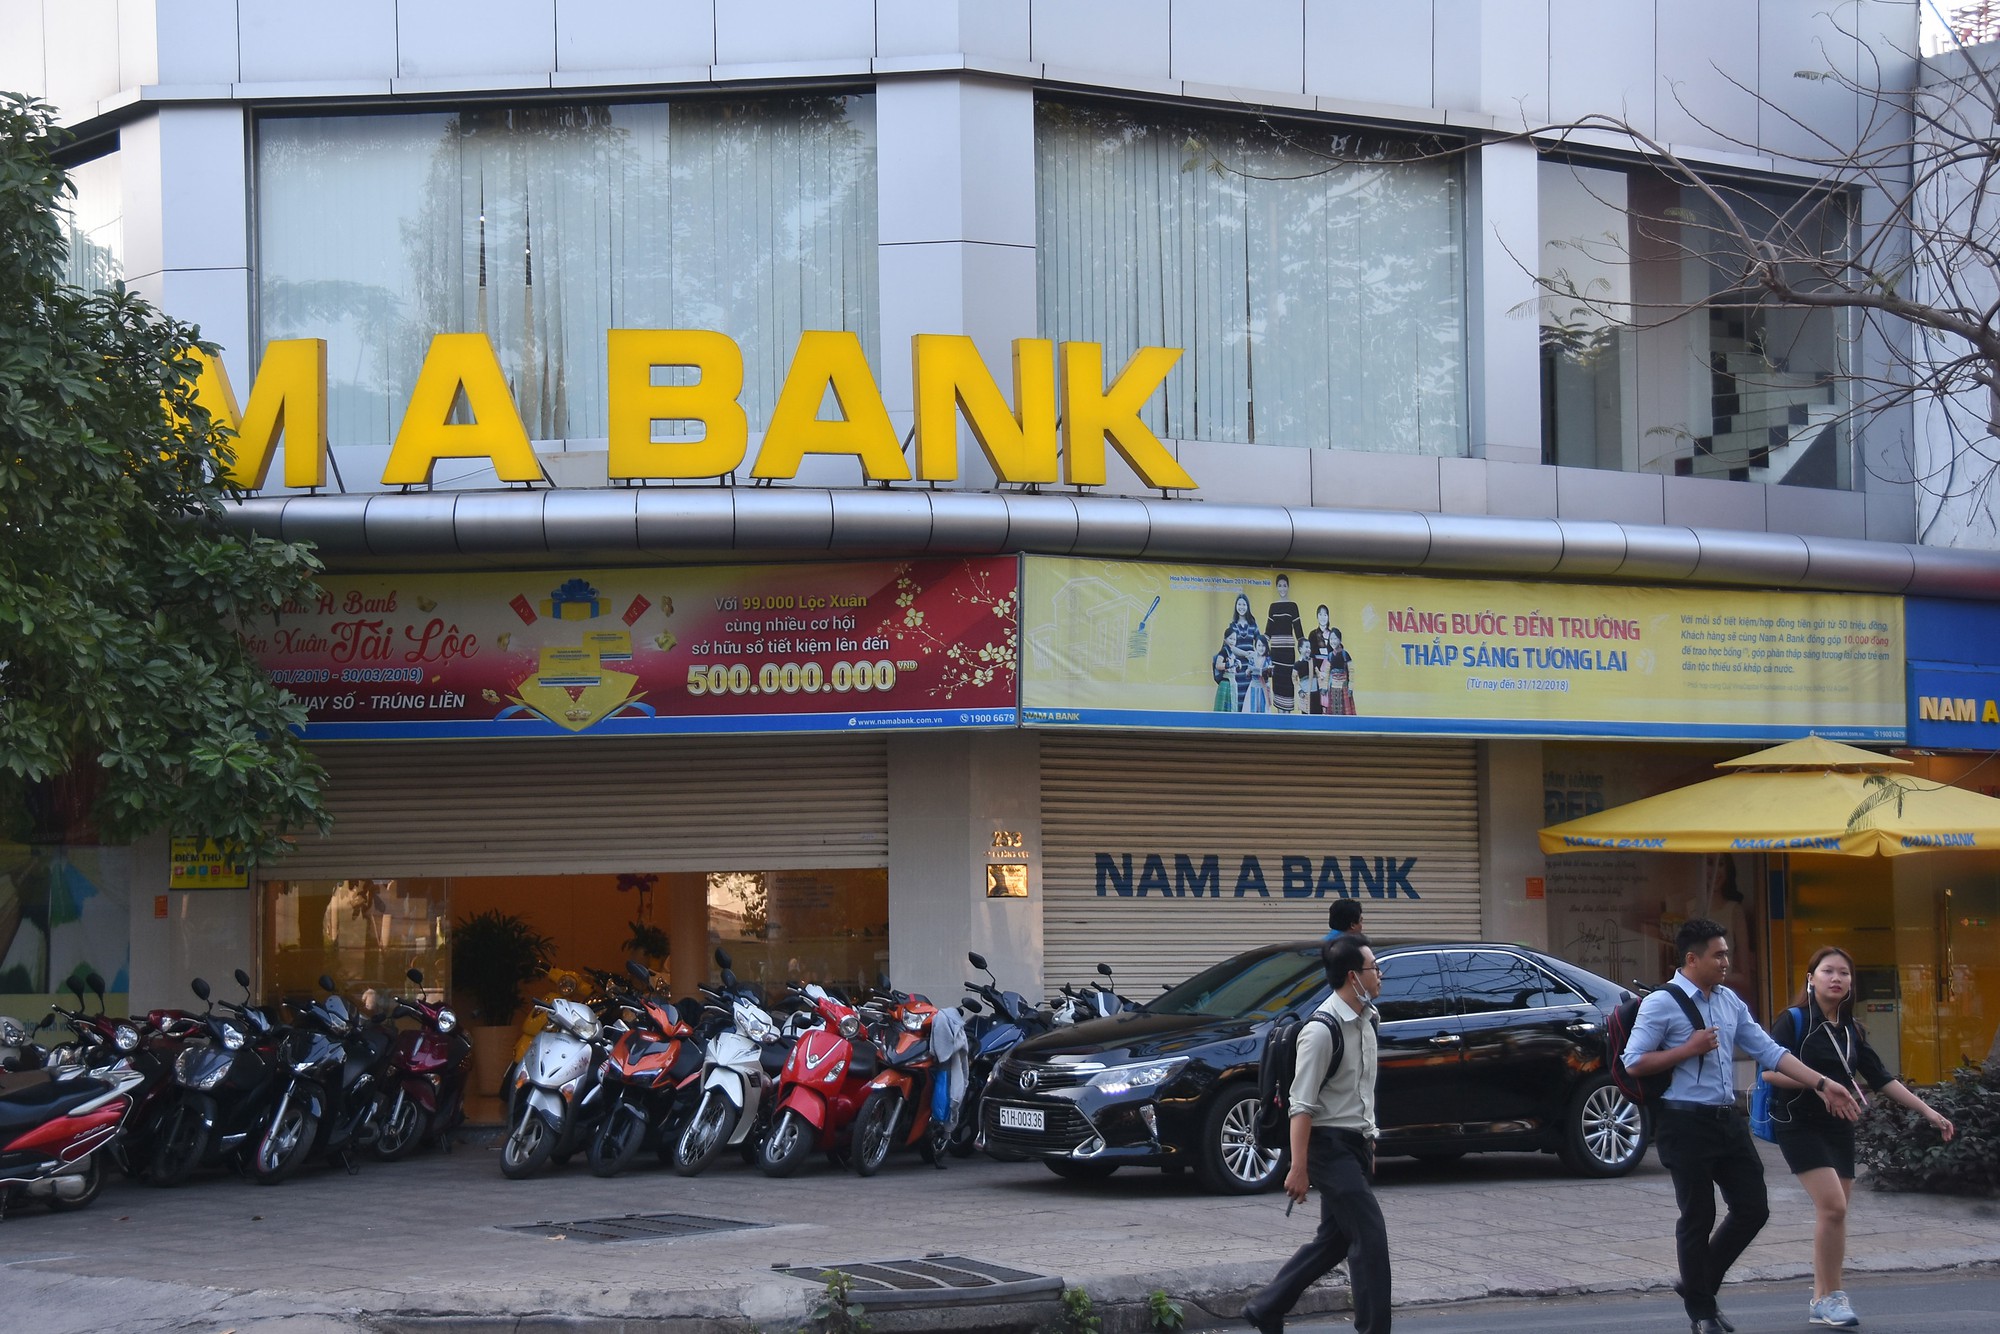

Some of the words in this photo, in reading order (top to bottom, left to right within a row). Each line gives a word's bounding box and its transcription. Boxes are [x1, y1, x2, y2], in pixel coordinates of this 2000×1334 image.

[381, 332, 545, 485] A
[607, 329, 1199, 489] BANK
[343, 590, 398, 614] Bank
[714, 597, 737, 610] Với
[742, 596, 794, 609] 99.000
[799, 596, 825, 611] Lộc
[830, 594, 867, 607] Xuân
[725, 619, 761, 634] cùng
[766, 616, 805, 631] nhiều
[811, 618, 829, 629] cơ
[833, 615, 855, 631] hội
[1387, 606, 1447, 635] NÂNG
[1451, 610, 1507, 636] BƯỚC
[1513, 609, 1554, 638] ĐẾN
[1558, 614, 1640, 640] TRƯỜNG
[1839, 620, 1847, 629] 50
[274, 628, 329, 654] Xuân
[330, 619, 394, 663] Tài
[405, 618, 480, 666] Lộc
[692, 640, 711, 654] sở
[714, 640, 741, 654] hữu
[767, 638, 791, 653] tiết
[796, 639, 831, 655] kiệm
[836, 638, 857, 651] lên
[862, 636, 889, 650] đến
[1759, 633, 1776, 642] Nam
[1778, 634, 1784, 642] A
[1787, 634, 1804, 643] Bank
[1844, 635, 1869, 644] 10.000
[1401, 637, 1458, 667] THẮP
[1462, 641, 1519, 668] SÁNG
[1523, 645, 1592, 670] TƯƠNG
[1596, 651, 1628, 672] LAI
[1853, 651, 1866, 659] cho
[341, 667, 423, 684] 30/03/2019)
[687, 660, 897, 695] 500.000.000
[1466, 678, 1481, 690] (Từ
[1483, 680, 1497, 691] nay
[1499, 678, 1515, 689] đến
[1517, 679, 1569, 691] 31/12/2018)
[333, 690, 357, 710] SỐ
[370, 691, 425, 709] TRÚNG
[429, 690, 465, 708] LIỀN
[1919, 696, 1976, 722] NAM
[1981, 699, 2000, 723] A
[858, 717, 943, 726] www.namabank.com.vn
[970, 714, 991, 723] 1900
[993, 714, 1014, 722] 6679
[1563, 835, 1602, 848] NAM
[1617, 837, 1667, 849] BANK
[1730, 838, 1773, 849] NAM
[1774, 838, 1786, 849] A
[1789, 837, 1841, 850] BANK
[1901, 834, 1932, 848] NAM
[1932, 834, 1943, 847] A
[1943, 832, 1976, 847] BANK
[1095, 852, 1220, 898] NAM
[1234, 855, 1271, 898] A
[1282, 856, 1421, 899] BANK
[1001, 1109, 1043, 1128] 51H-003.36
